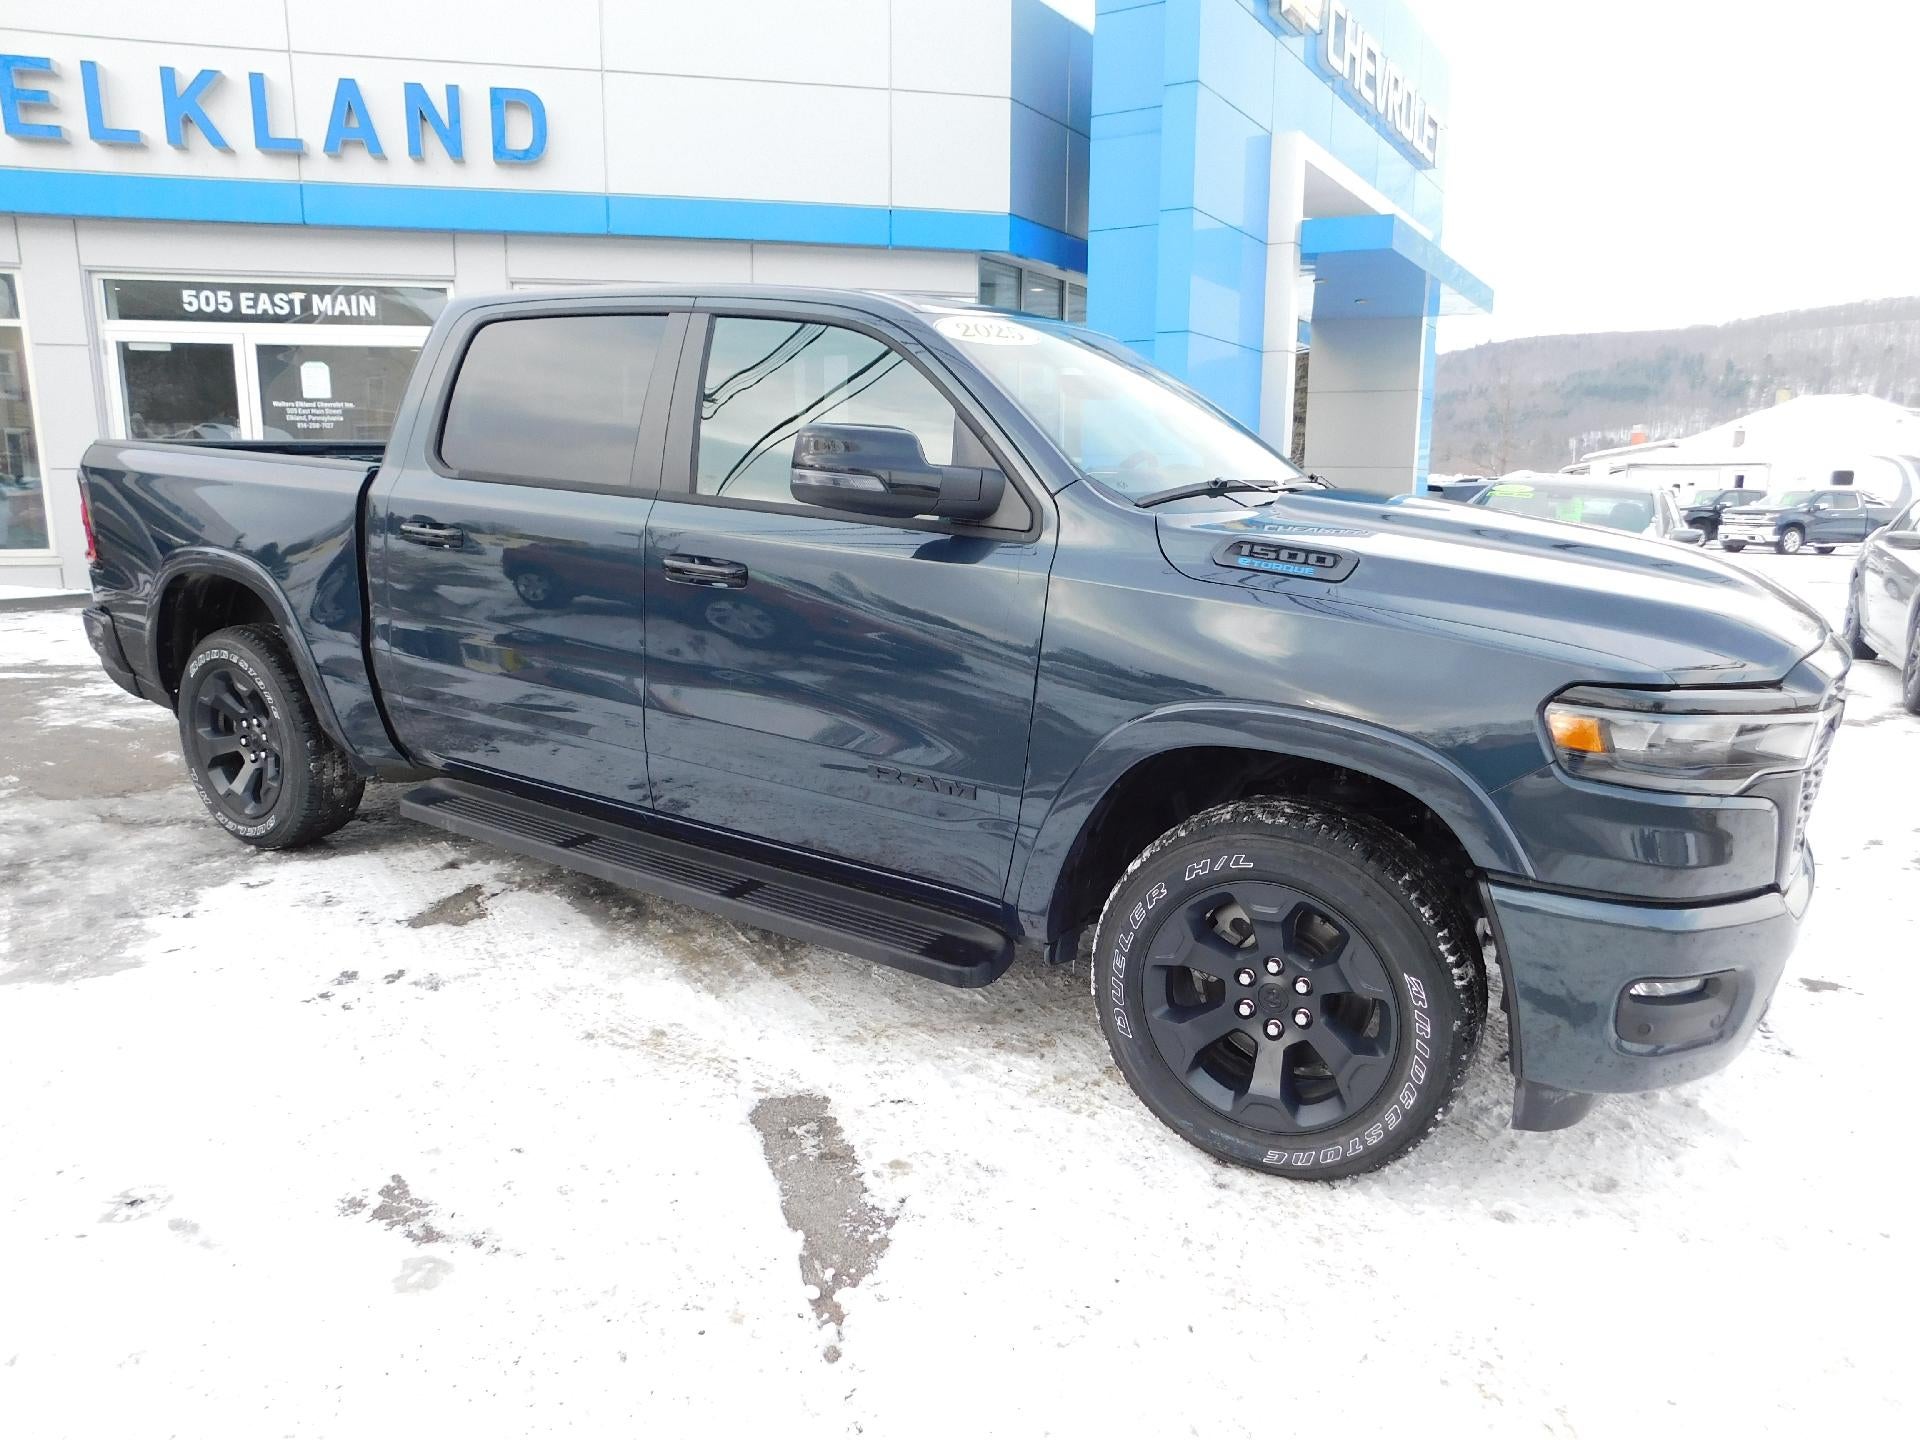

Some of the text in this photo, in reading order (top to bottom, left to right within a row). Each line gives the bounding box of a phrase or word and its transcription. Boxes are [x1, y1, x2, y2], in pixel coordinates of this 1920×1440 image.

[0, 54, 549, 164] ELKLAND
[182, 289, 376, 317] 505 EAST MAIN
[955, 322, 1025, 341] 2025
[317, 401, 343, 409] Chevrolet
[1239, 543, 1336, 567] 1500
[867, 763, 977, 801] RAM
[1111, 854, 1254, 1039] DUELER H/L
[1262, 972, 1431, 1166] BRIDGESTONE
